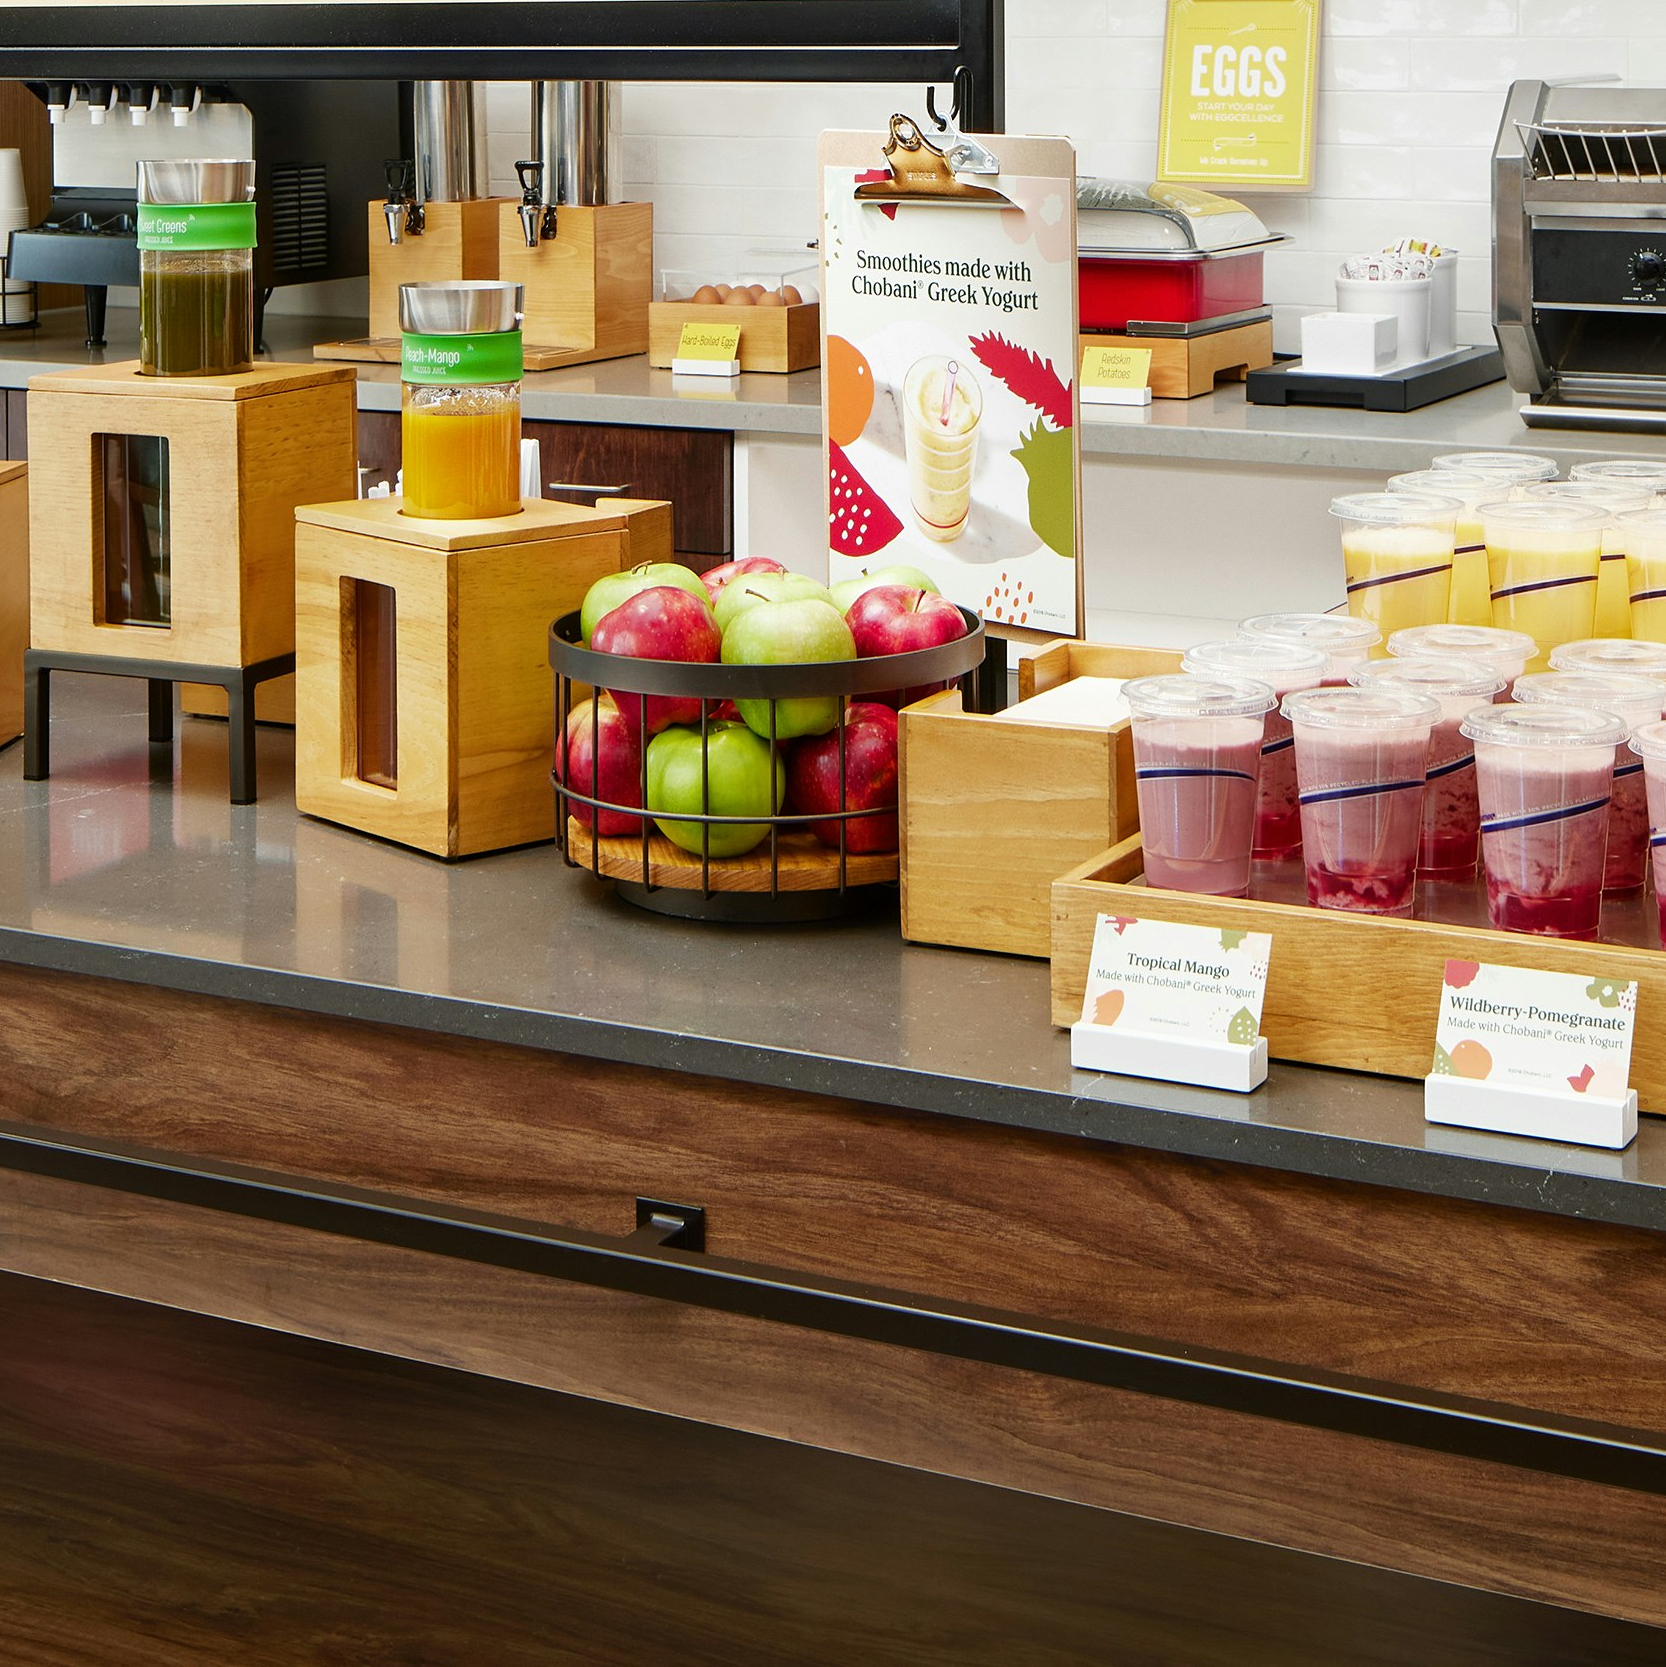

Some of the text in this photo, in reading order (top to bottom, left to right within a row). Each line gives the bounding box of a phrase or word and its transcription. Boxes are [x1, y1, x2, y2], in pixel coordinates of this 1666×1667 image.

[1191, 44, 1287, 98] EGGS
[1189, 113, 1285, 123] WITH EGGCELLENCE
[1197, 102, 1226, 111] START
[1228, 103, 1254, 111] YOUR
[156, 218, 187, 233] Greens
[856, 249, 1032, 282] Smoothies made with
[927, 281, 978, 305] Greek
[982, 286, 1038, 313] Yogurt
[682, 335, 736, 350] Hard-Boiled Eggs
[405, 346, 460, 367] Peach-Mango
[1102, 353, 1131, 365] Redskin
[1098, 366, 1131, 379] Potatoes
[1127, 952, 1230, 979] Tropical Mango
[1096, 968, 1122, 981] Made
[1124, 971, 1144, 984] with
[1193, 981, 1222, 994] Greek
[1224, 985, 1256, 999] Yogurt
[1450, 995, 1626, 1031] Wildberry-Pomegranate
[1447, 1016, 1475, 1029] Made
[1478, 1020, 1500, 1032] with
[1554, 1030, 1586, 1044] Greek
[1589, 1034, 1624, 1050] Yogurt
